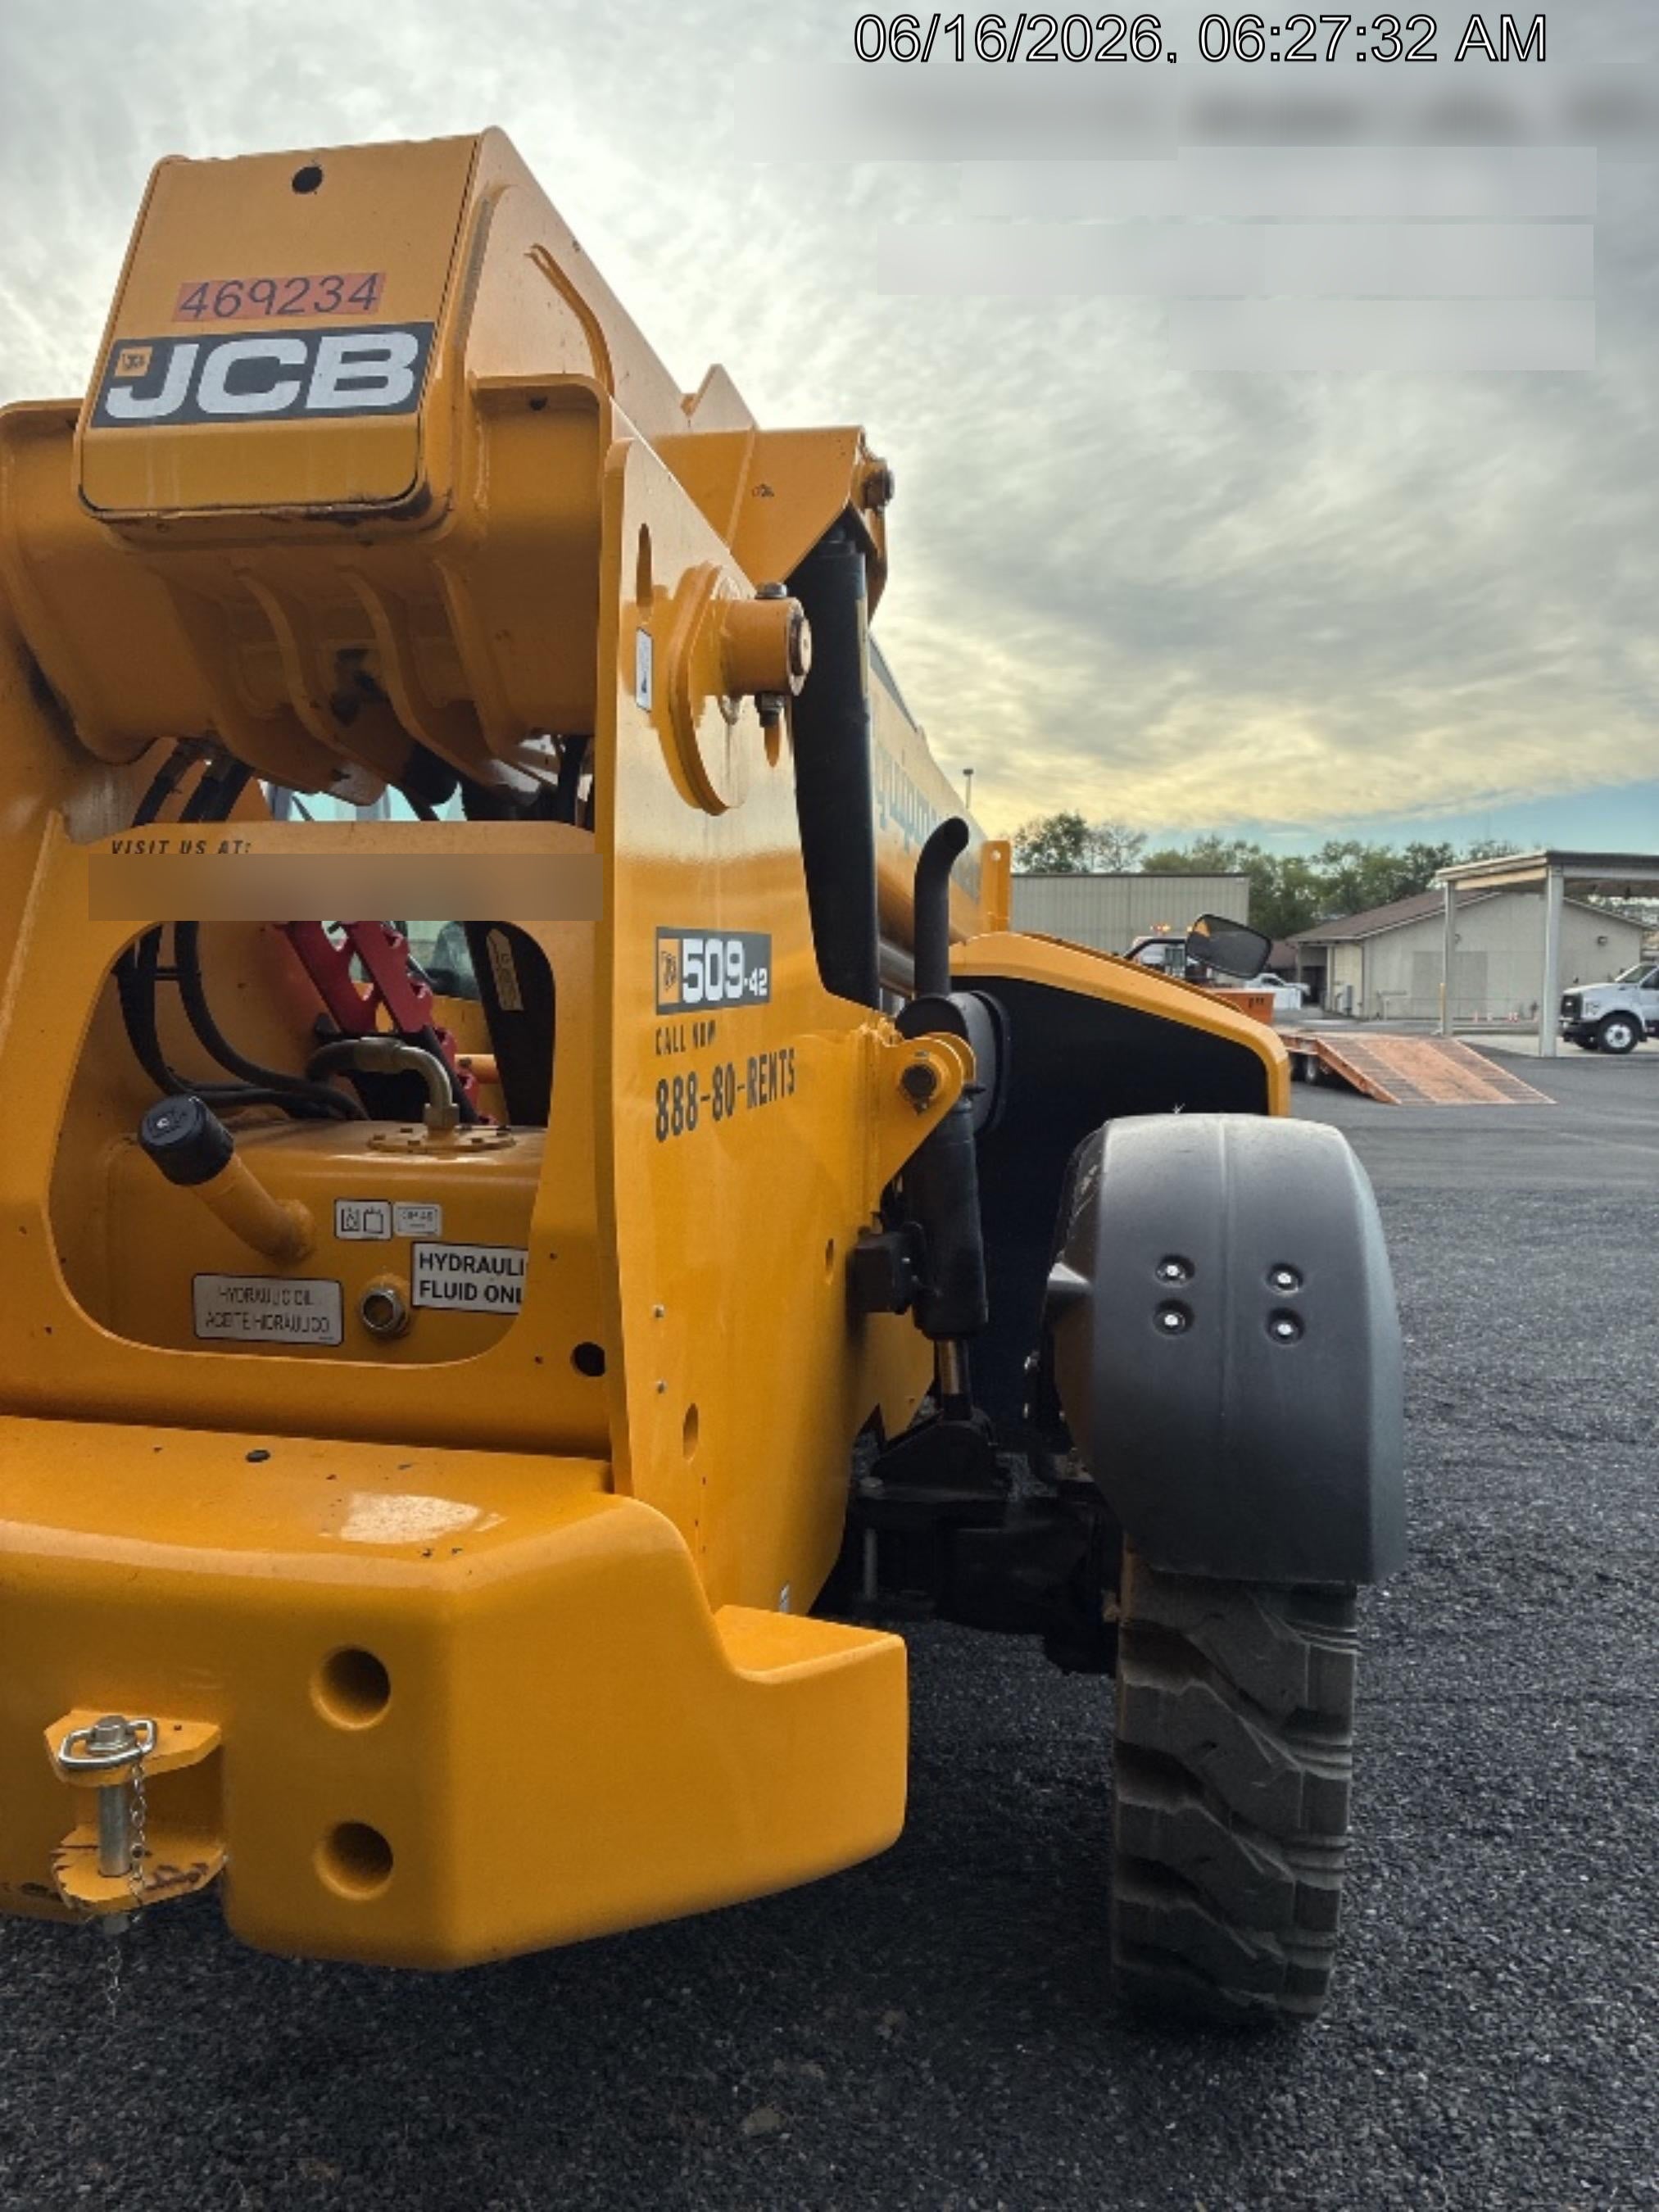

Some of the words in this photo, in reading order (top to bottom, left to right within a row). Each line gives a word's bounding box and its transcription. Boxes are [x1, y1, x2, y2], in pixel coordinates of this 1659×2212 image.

[179, 273, 378, 319] 469234
[105, 332, 419, 419] JCB
[111, 840, 170, 854] VISIT
[179, 840, 206, 854] US
[655, 1024, 687, 1056] CALL
[656, 1047, 796, 1144] 888-80-RENTS
[419, 1252, 524, 1277] HYDRAULI
[419, 1280, 478, 1300] FLUID
[483, 1284, 522, 1304] ONL
